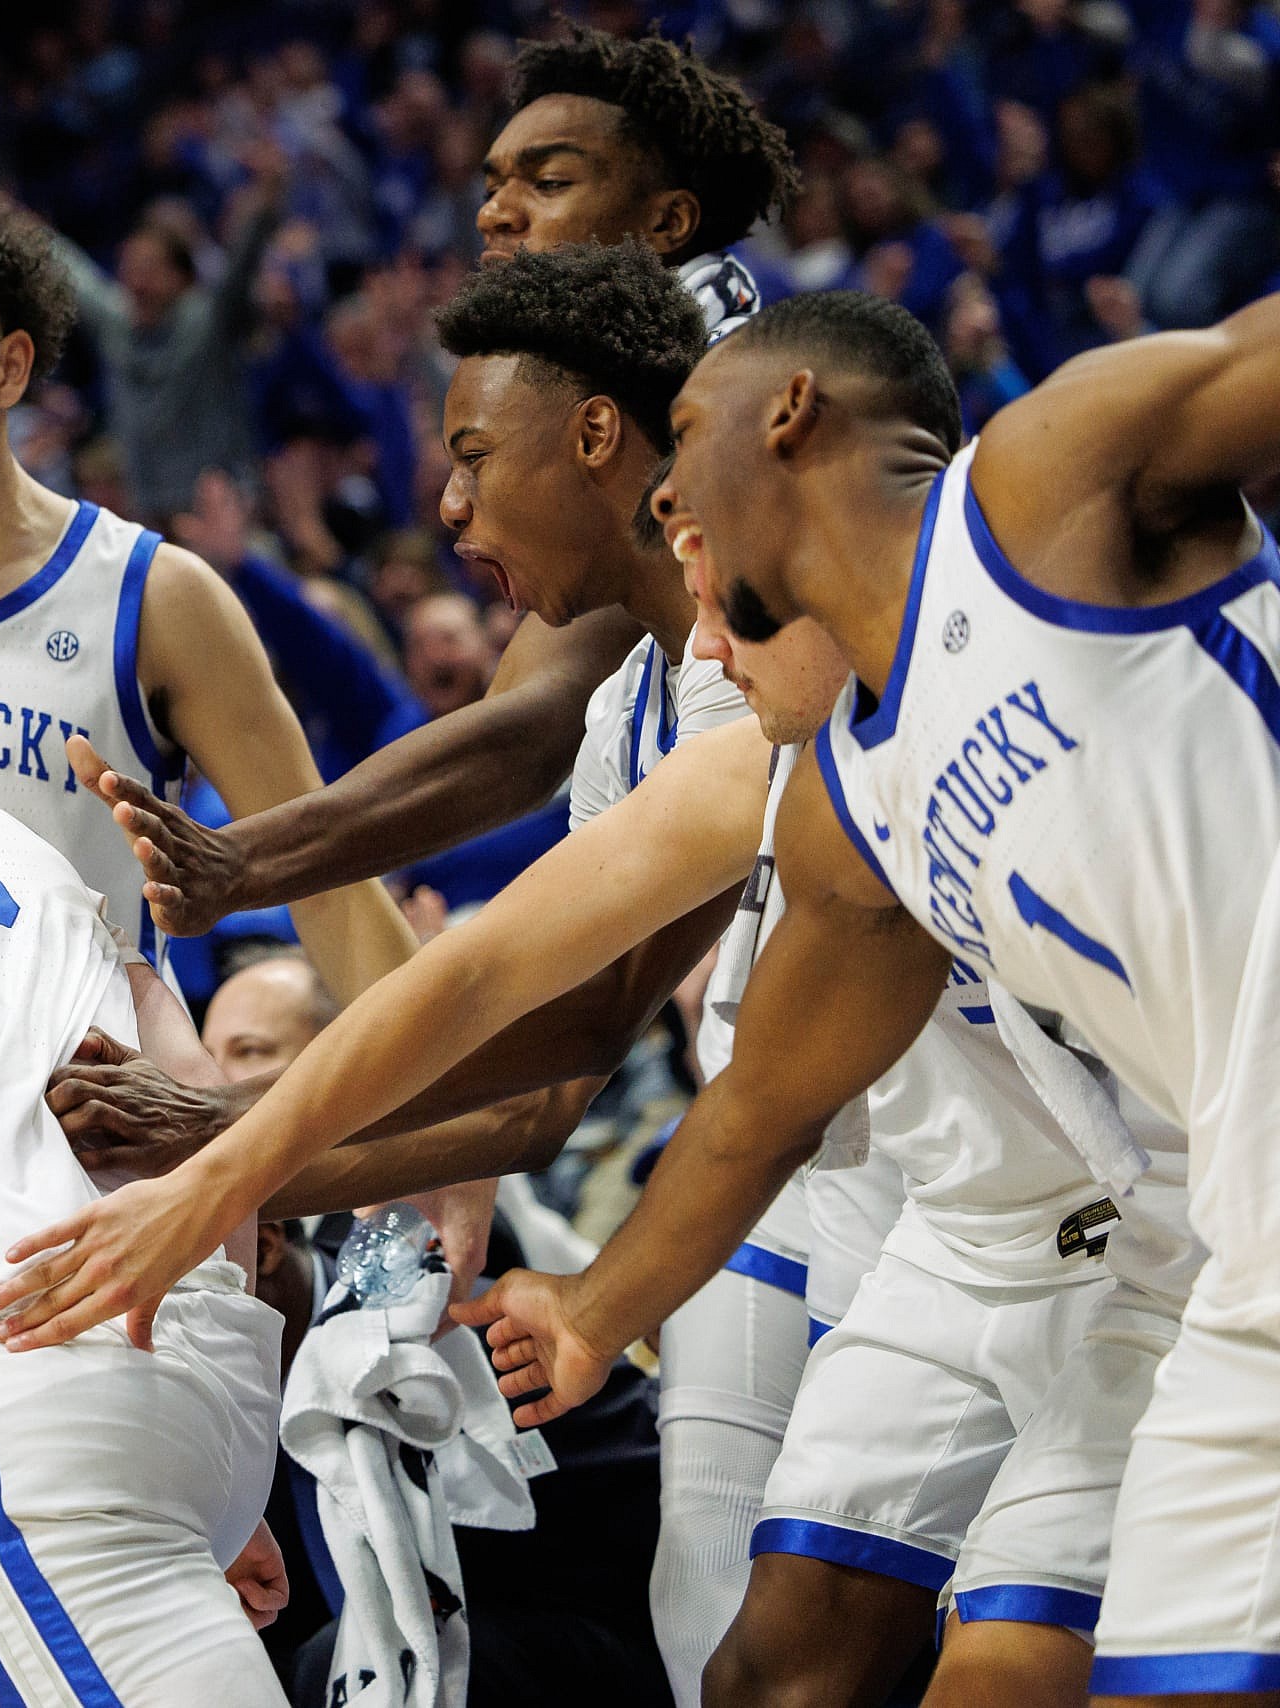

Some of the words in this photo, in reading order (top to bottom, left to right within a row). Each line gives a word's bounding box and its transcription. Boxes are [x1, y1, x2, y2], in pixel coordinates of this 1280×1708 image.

[47, 630, 79, 661] SEC
[923, 679, 1079, 972] KENTUCKY
[1006, 869, 1137, 999] 1
